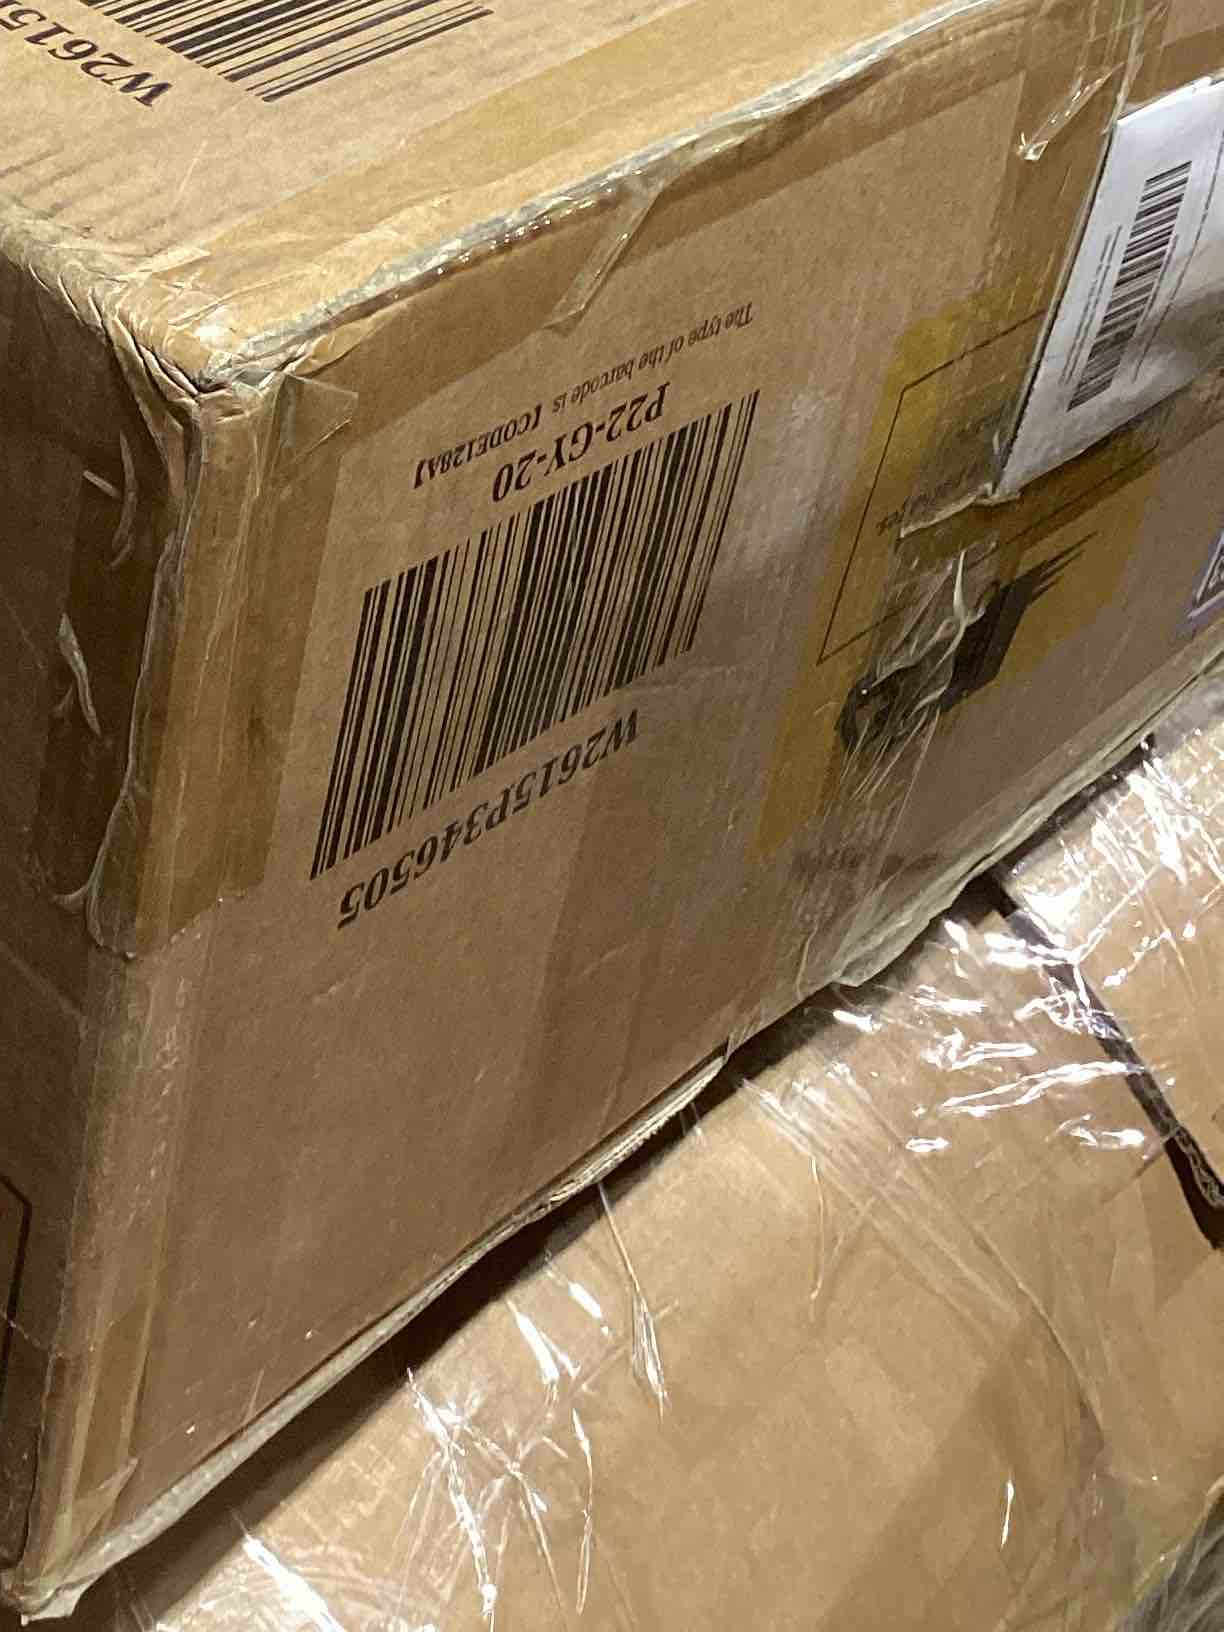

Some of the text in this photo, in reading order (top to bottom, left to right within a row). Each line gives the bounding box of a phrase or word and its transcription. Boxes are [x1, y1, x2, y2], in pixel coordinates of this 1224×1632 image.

[725, 303, 754, 331] The
[688, 317, 722, 348] type
[638, 343, 665, 369] the
[665, 335, 686, 365] of
[570, 361, 635, 405] barcode
[551, 392, 568, 415] is
[491, 381, 672, 504] P22-GY-20
[336, 707, 641, 931] W2615P346505
